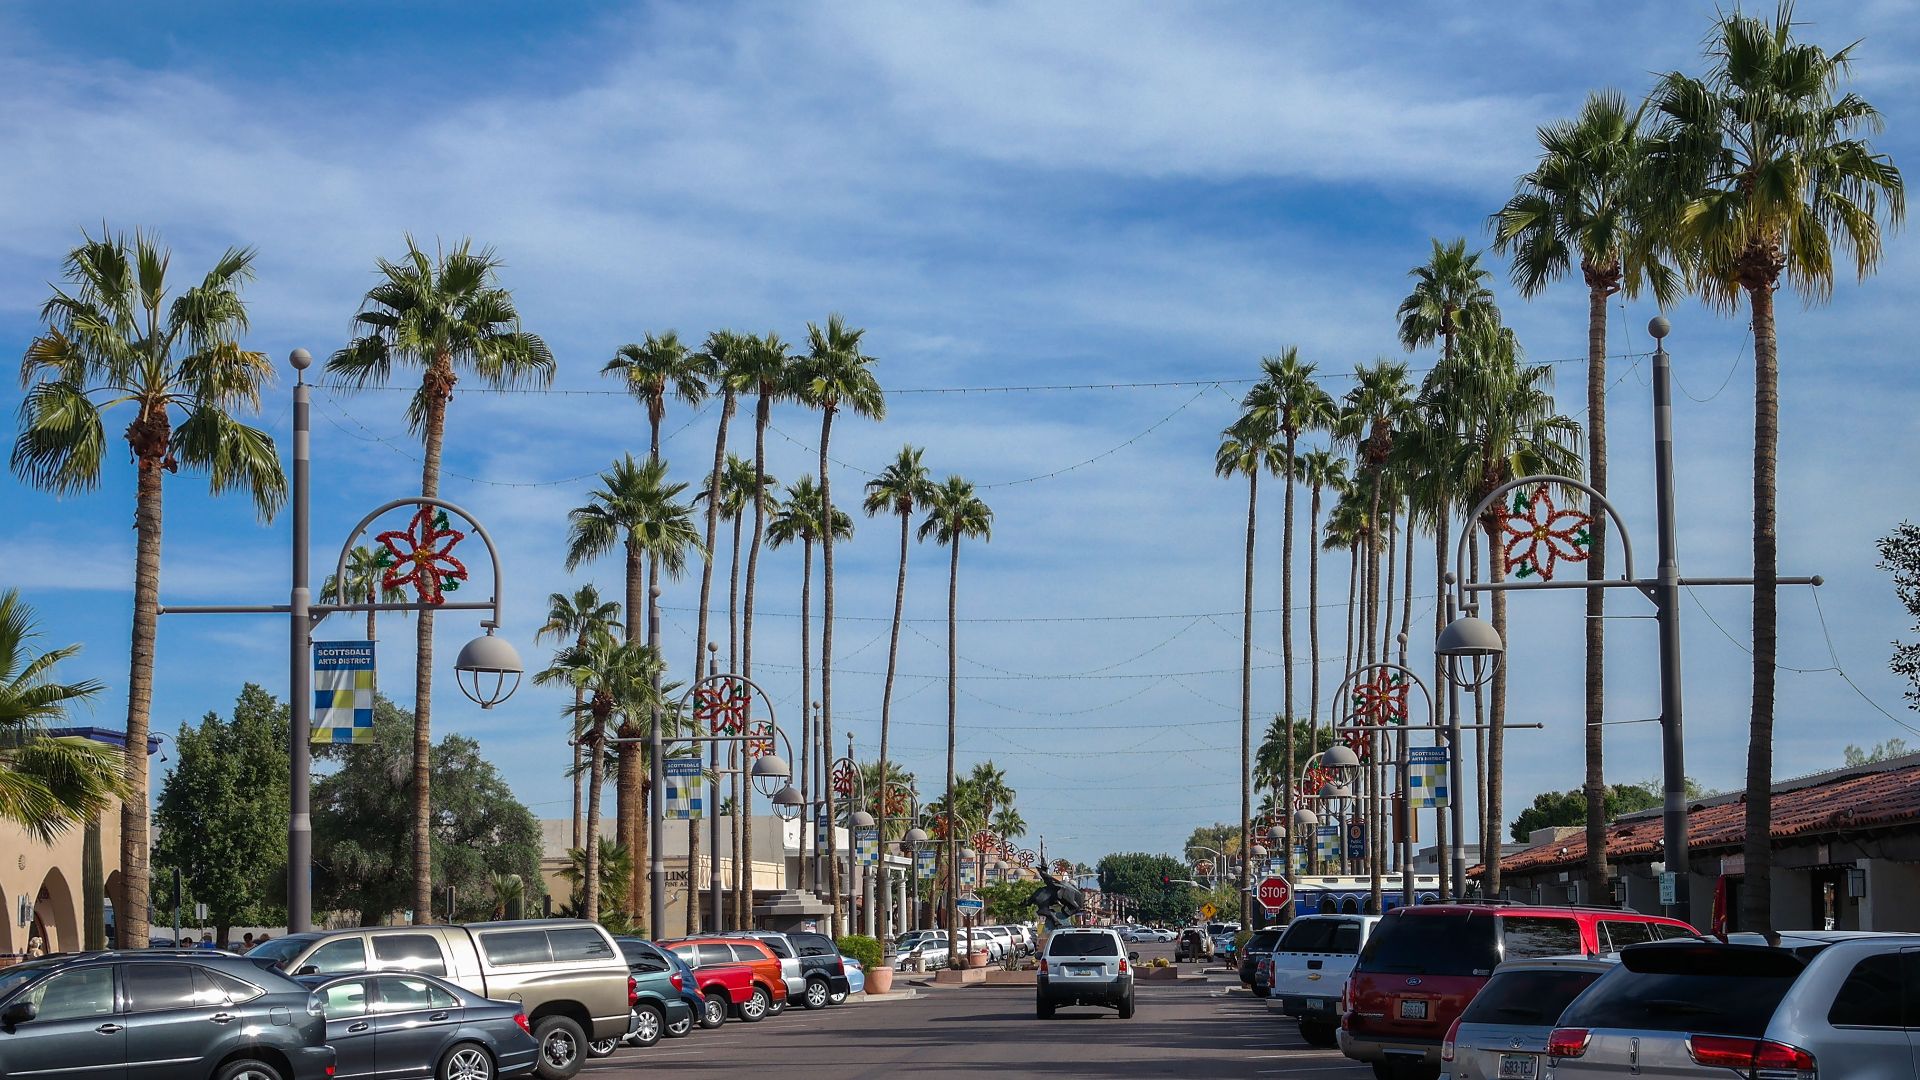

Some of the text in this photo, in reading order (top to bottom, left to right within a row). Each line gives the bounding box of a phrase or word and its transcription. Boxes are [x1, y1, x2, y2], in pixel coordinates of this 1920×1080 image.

[317, 648, 371, 656] SCOTTSDALE
[338, 657, 371, 665] DISTRICT
[1261, 886, 1287, 898] STOP
